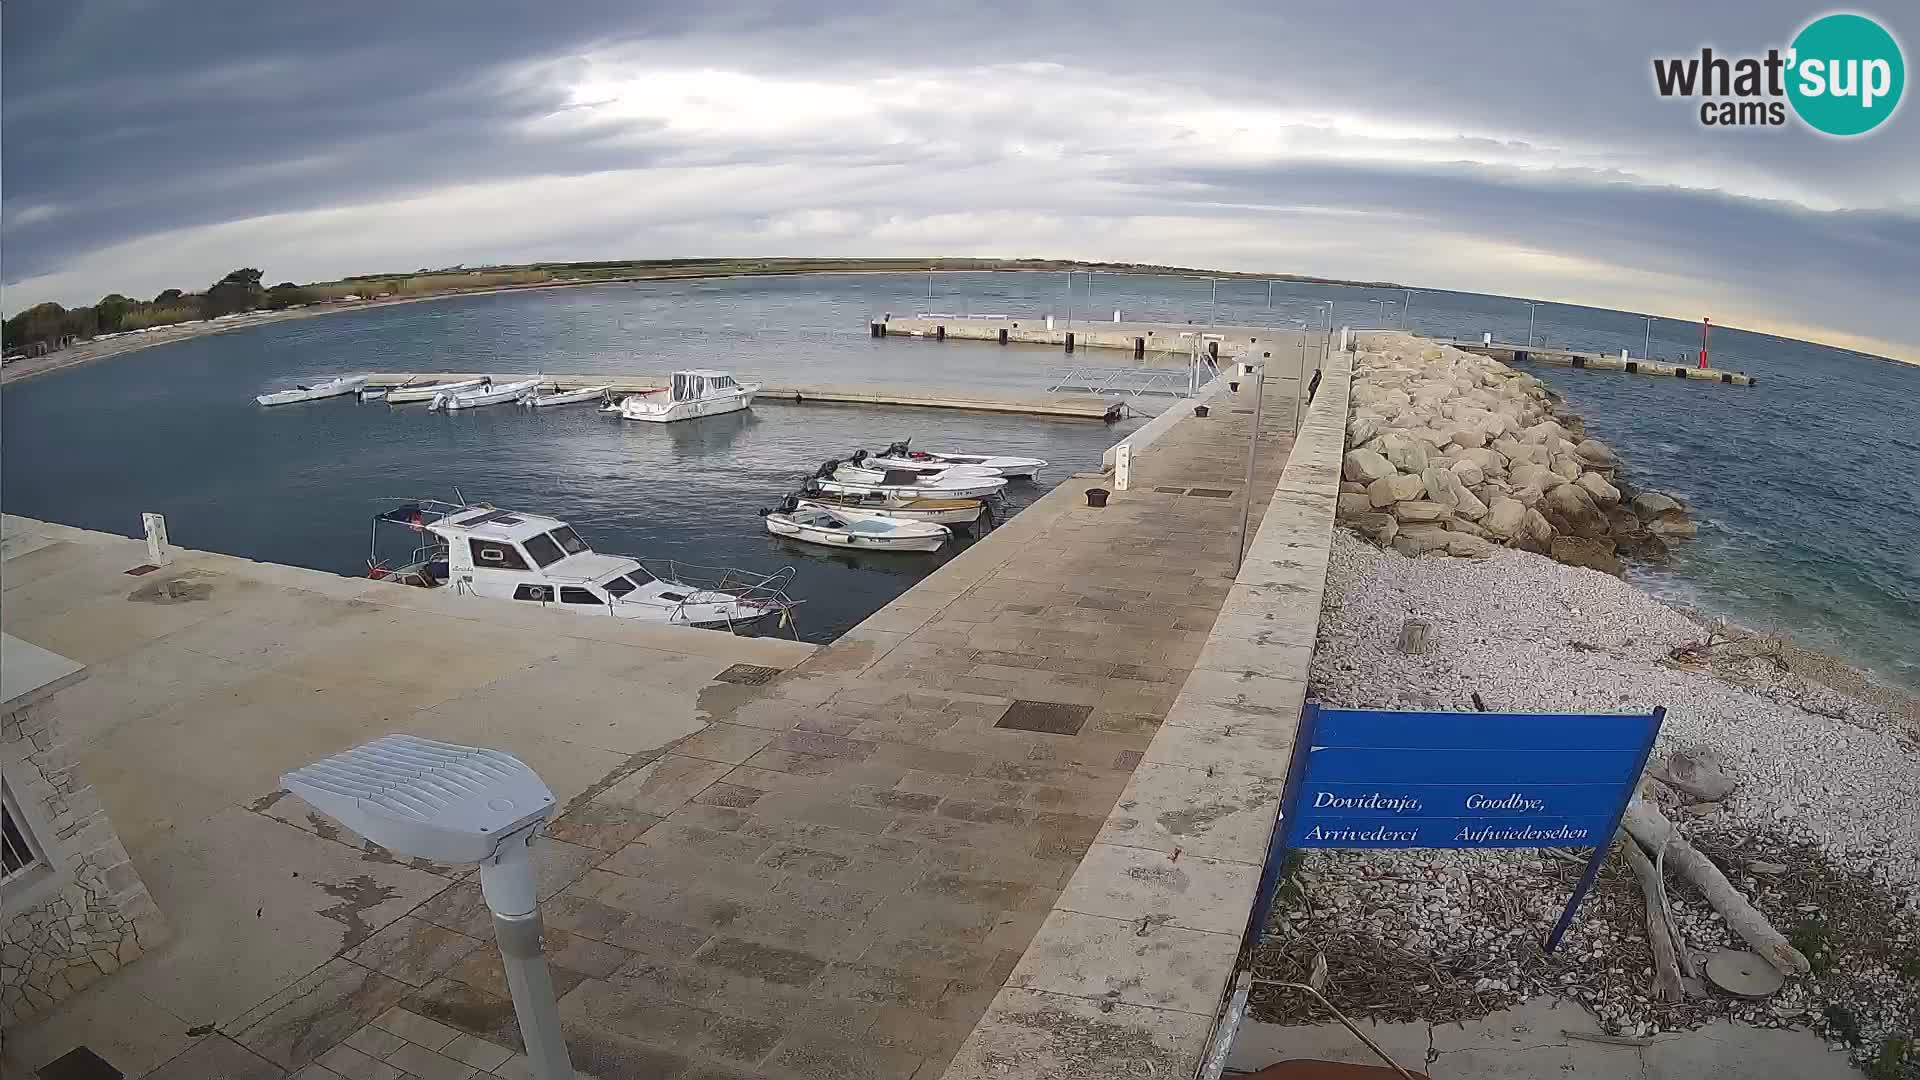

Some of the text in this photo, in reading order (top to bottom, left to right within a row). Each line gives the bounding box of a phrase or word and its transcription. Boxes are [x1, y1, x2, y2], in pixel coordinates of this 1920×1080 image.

[1465, 793, 1545, 813] Goodbye,
[1304, 825, 1419, 841] Arrivederci
[1453, 824, 1588, 843] Aufwiedersehen
